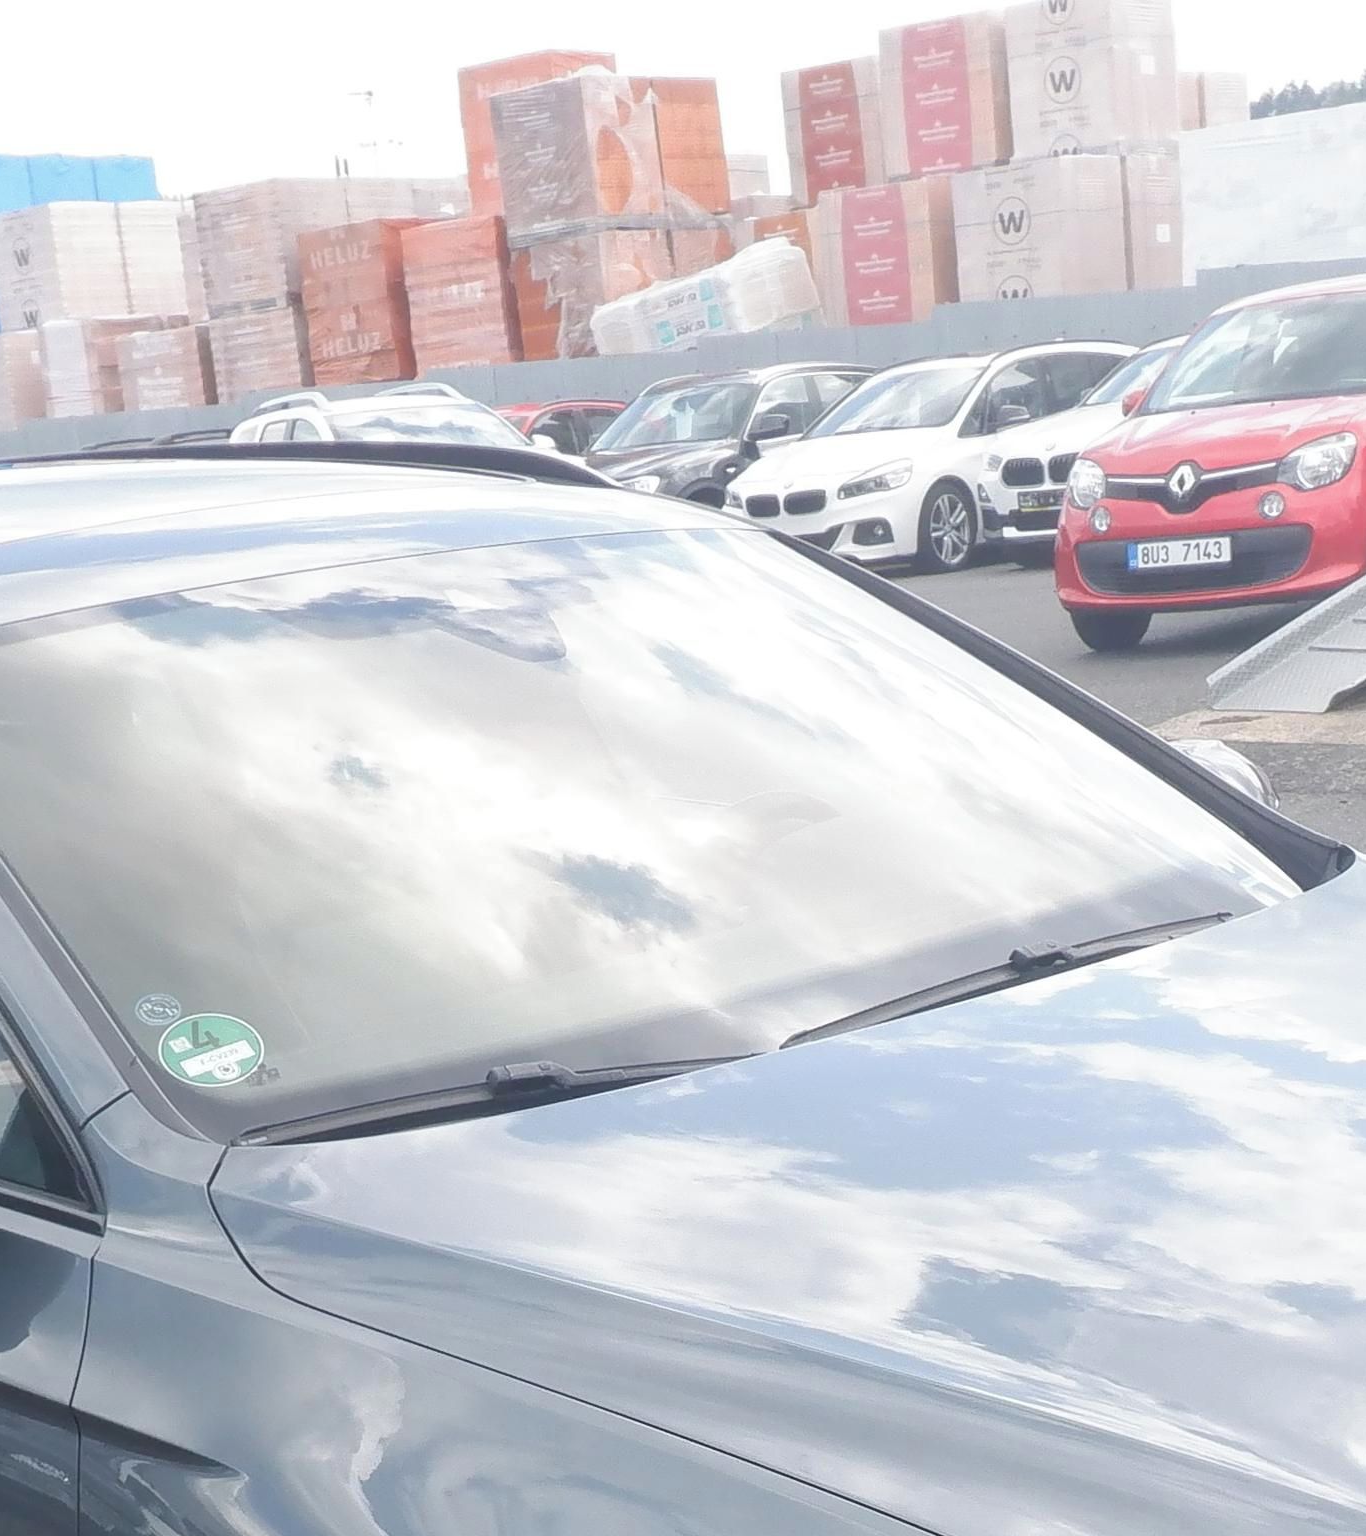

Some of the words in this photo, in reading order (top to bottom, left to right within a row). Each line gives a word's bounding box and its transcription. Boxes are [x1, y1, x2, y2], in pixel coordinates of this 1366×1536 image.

[1049, 69, 1076, 93] W
[998, 209, 1025, 235] W
[13, 248, 31, 267] W
[310, 240, 372, 270] HELUZ
[322, 331, 381, 359] HELUZ
[1141, 545, 1170, 565] 8U3
[1181, 541, 1223, 562] 7143
[192, 1020, 220, 1048] 4
